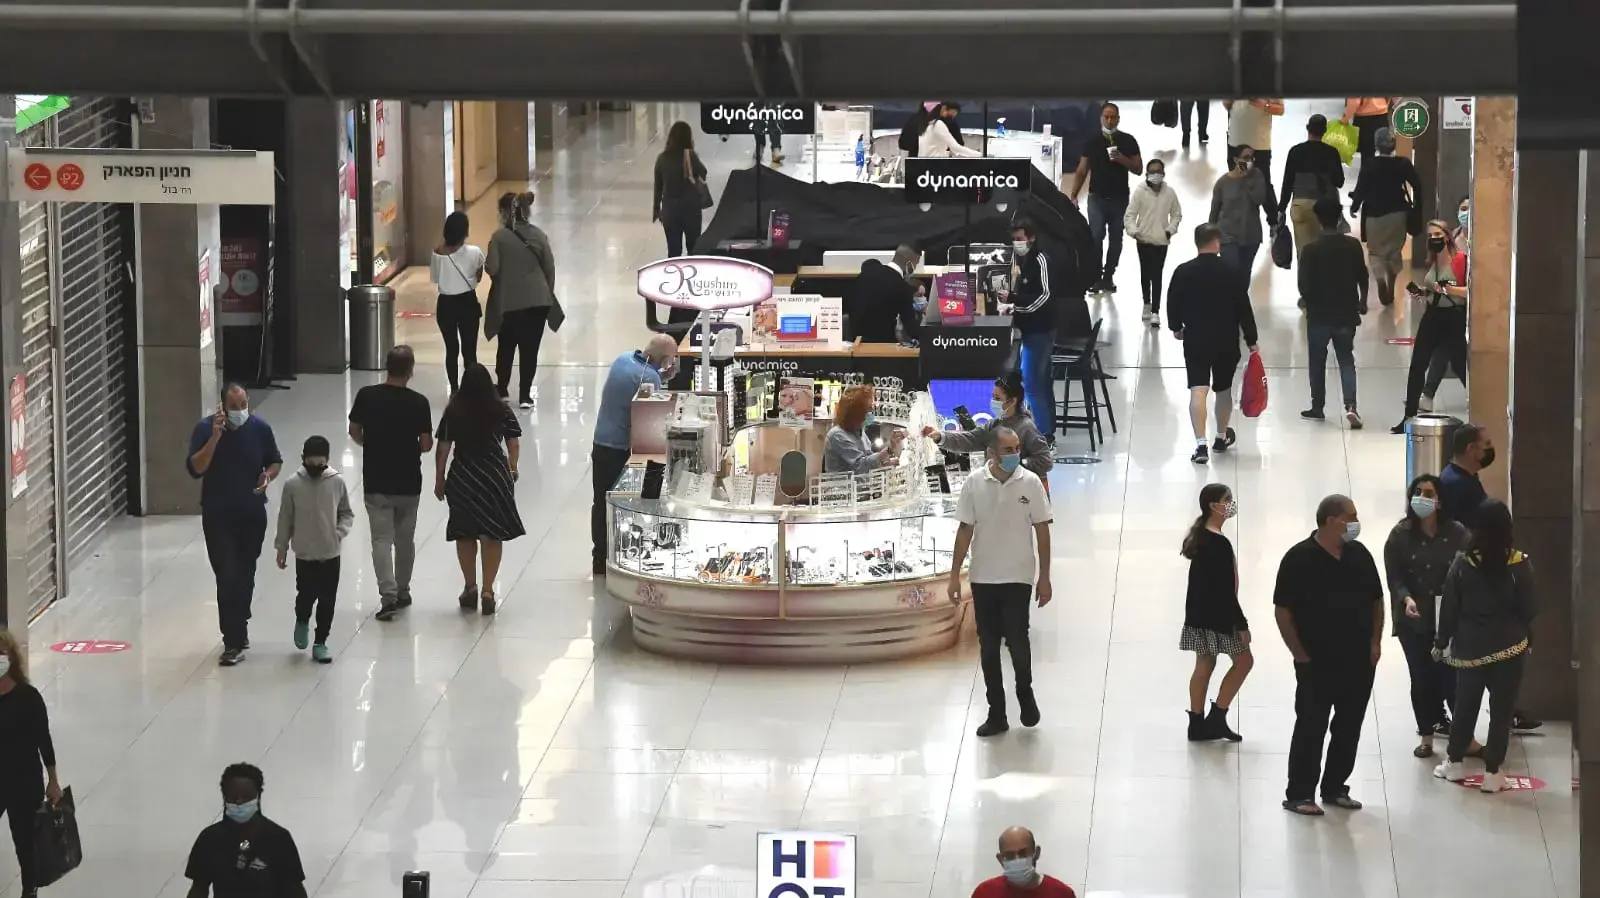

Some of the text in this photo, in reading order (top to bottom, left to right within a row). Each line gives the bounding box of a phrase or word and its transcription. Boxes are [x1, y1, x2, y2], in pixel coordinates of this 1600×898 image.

[711, 104, 804, 125] dynamica
[102, 165, 191, 181] חניון הפארק
[916, 170, 1019, 192] dynamica
[659, 264, 738, 297] Rigushim
[932, 334, 998, 349] dynamica
[738, 358, 798, 371] ynamica
